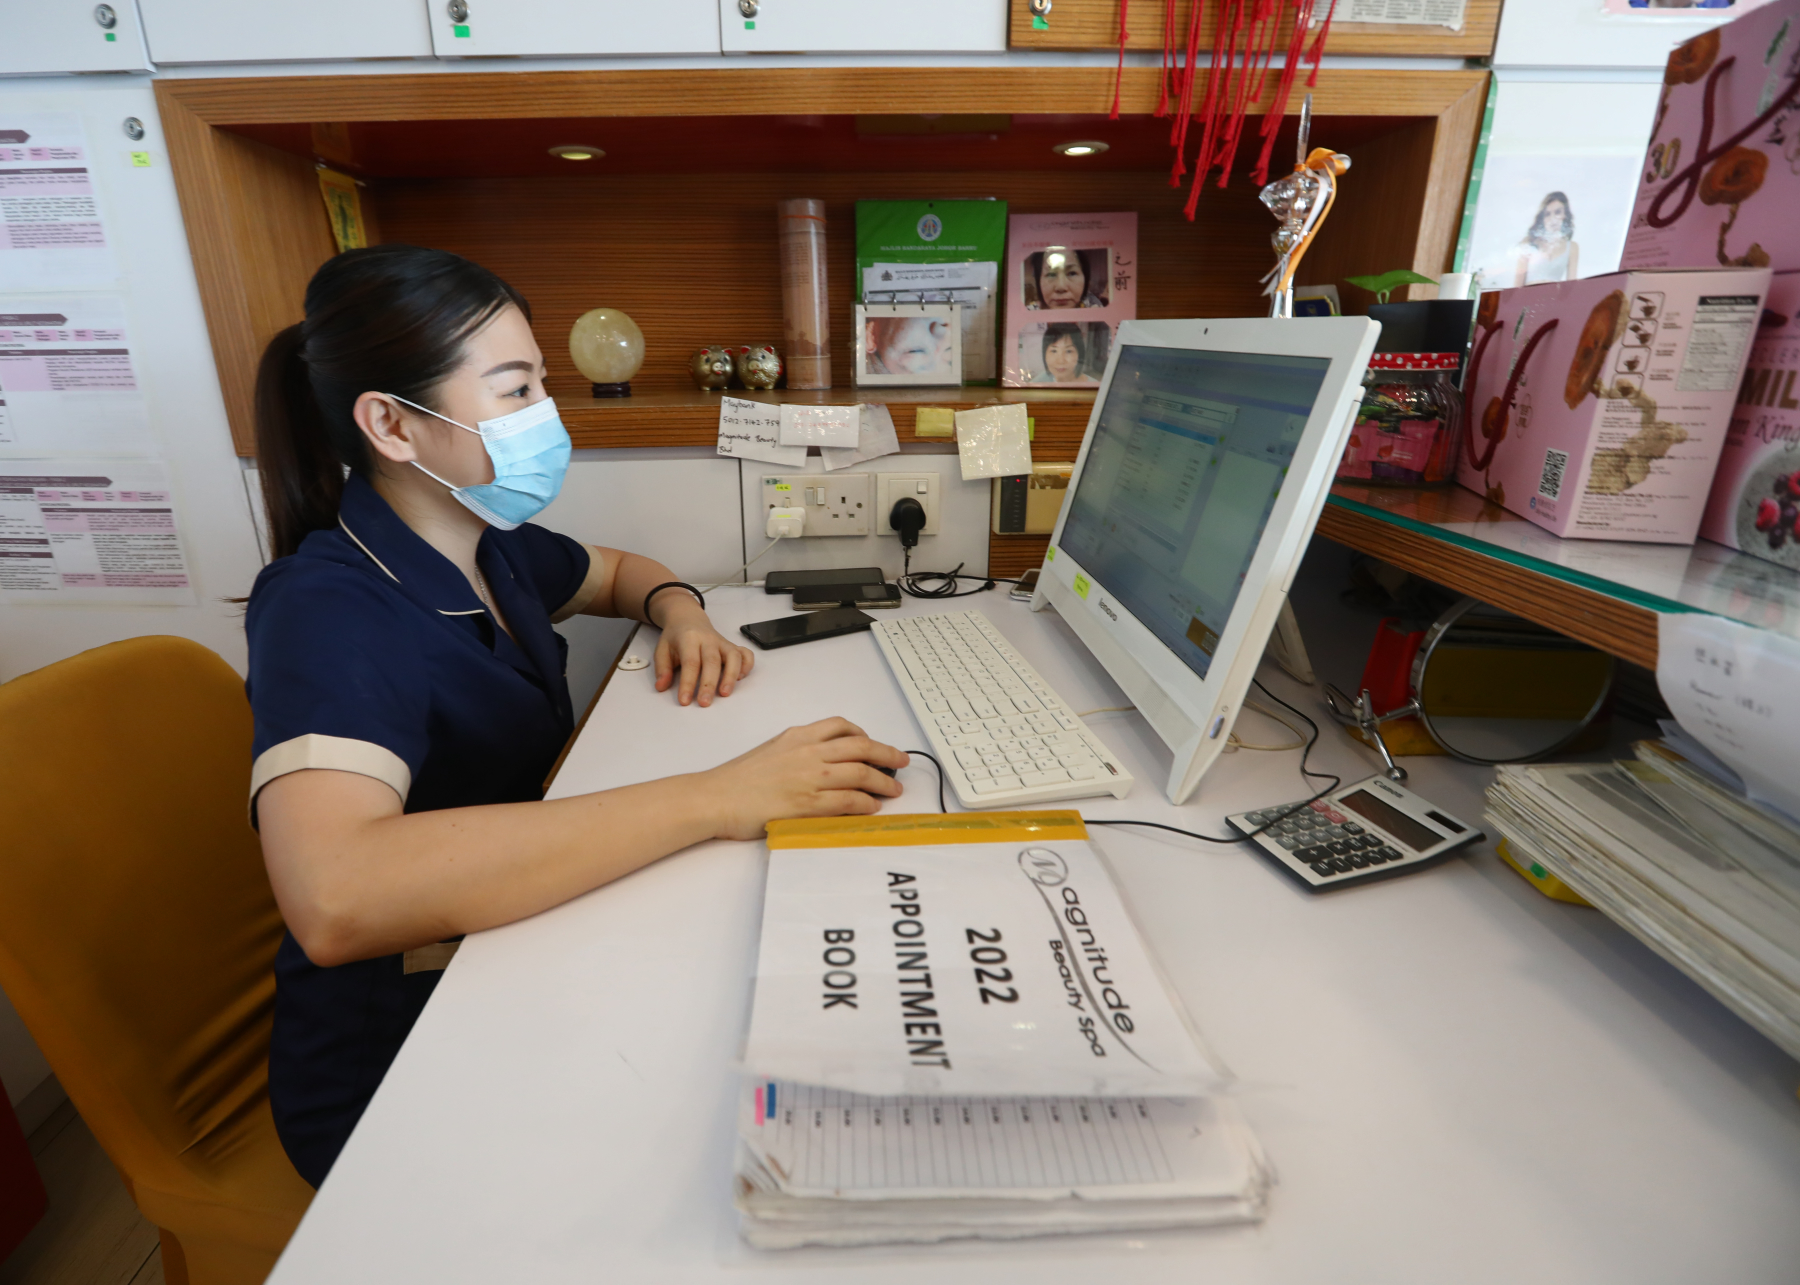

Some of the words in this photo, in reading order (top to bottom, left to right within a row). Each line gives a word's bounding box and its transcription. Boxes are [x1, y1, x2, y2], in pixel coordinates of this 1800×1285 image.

[723, 399, 756, 413] Maybank
[1373, 780, 1404, 799] Canon
[823, 929, 858, 1010] BOOK
[886, 871, 952, 1070] APPOINTMENT
[965, 928, 1020, 1005] 2022
[1048, 939, 1086, 1012] Beauty
[1078, 1016, 1107, 1058] Spa
